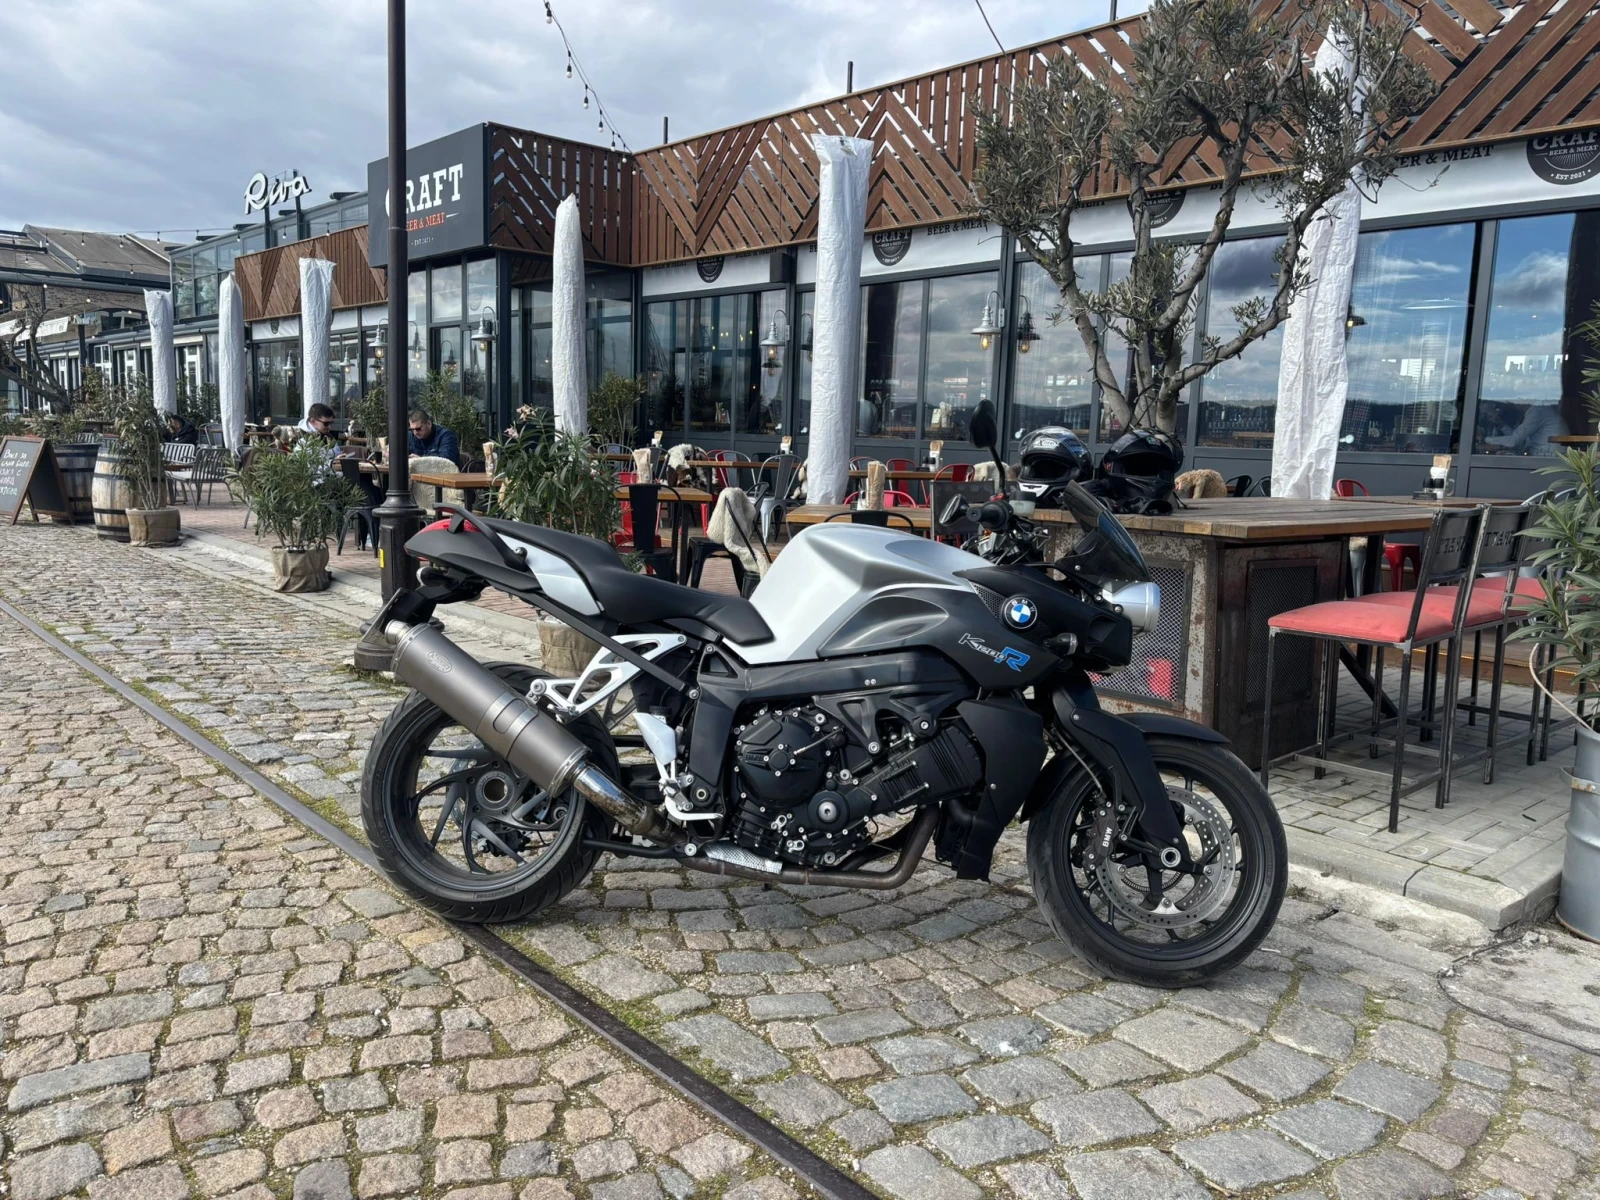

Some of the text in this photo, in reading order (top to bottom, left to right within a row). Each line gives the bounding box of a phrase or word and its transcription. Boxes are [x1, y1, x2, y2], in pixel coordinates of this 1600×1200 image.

[1532, 131, 1600, 150] CRAF
[1549, 148, 1568, 156] BEER
[1576, 144, 1599, 153] MEAT
[1425, 152, 1438, 165] &
[1442, 144, 1494, 163] MEAT
[1570, 170, 1586, 180] 2021
[244, 172, 312, 215] Riva
[406, 219, 418, 231] EER
[425, 211, 446, 226] MEAT
[927, 224, 951, 236] BEER
[952, 222, 959, 232] &
[1102, 826, 1113, 848] BMW
